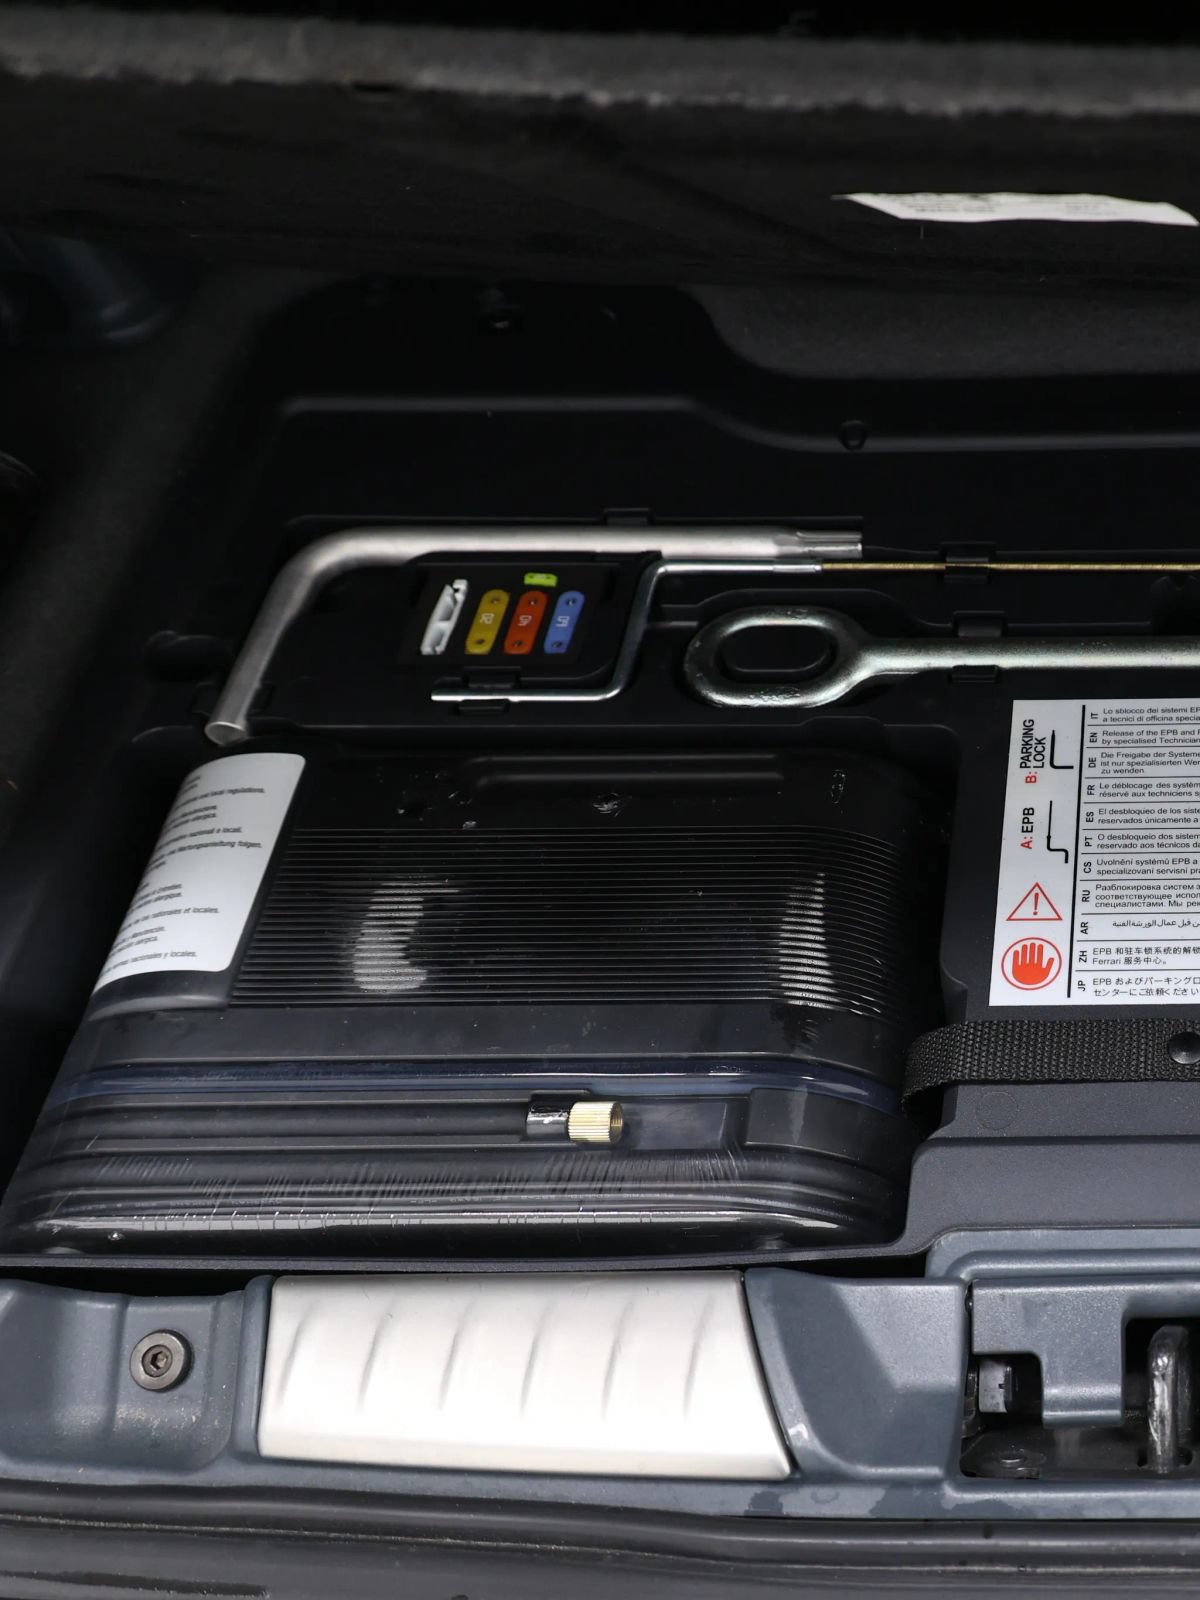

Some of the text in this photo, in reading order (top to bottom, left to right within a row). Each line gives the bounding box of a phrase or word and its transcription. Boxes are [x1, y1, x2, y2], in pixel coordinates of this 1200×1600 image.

[1089, 732, 1097, 742] EN
[1019, 719, 1034, 768] PARKING
[1032, 737, 1046, 768] LOCK
[1116, 751, 1151, 759] Freigabe
[1088, 757, 1096, 768] DE
[1086, 784, 1094, 795] FR
[1021, 807, 1034, 833] EPB
[1085, 811, 1094, 822] ES
[1084, 836, 1092, 846] PT
[1106, 833, 1156, 841] desbloqueio
[1083, 861, 1091, 873] CS
[1081, 889, 1090, 902] RU
[1080, 921, 1088, 934] AR
[1078, 950, 1087, 962] ZH
[1077, 980, 1085, 991] JP
